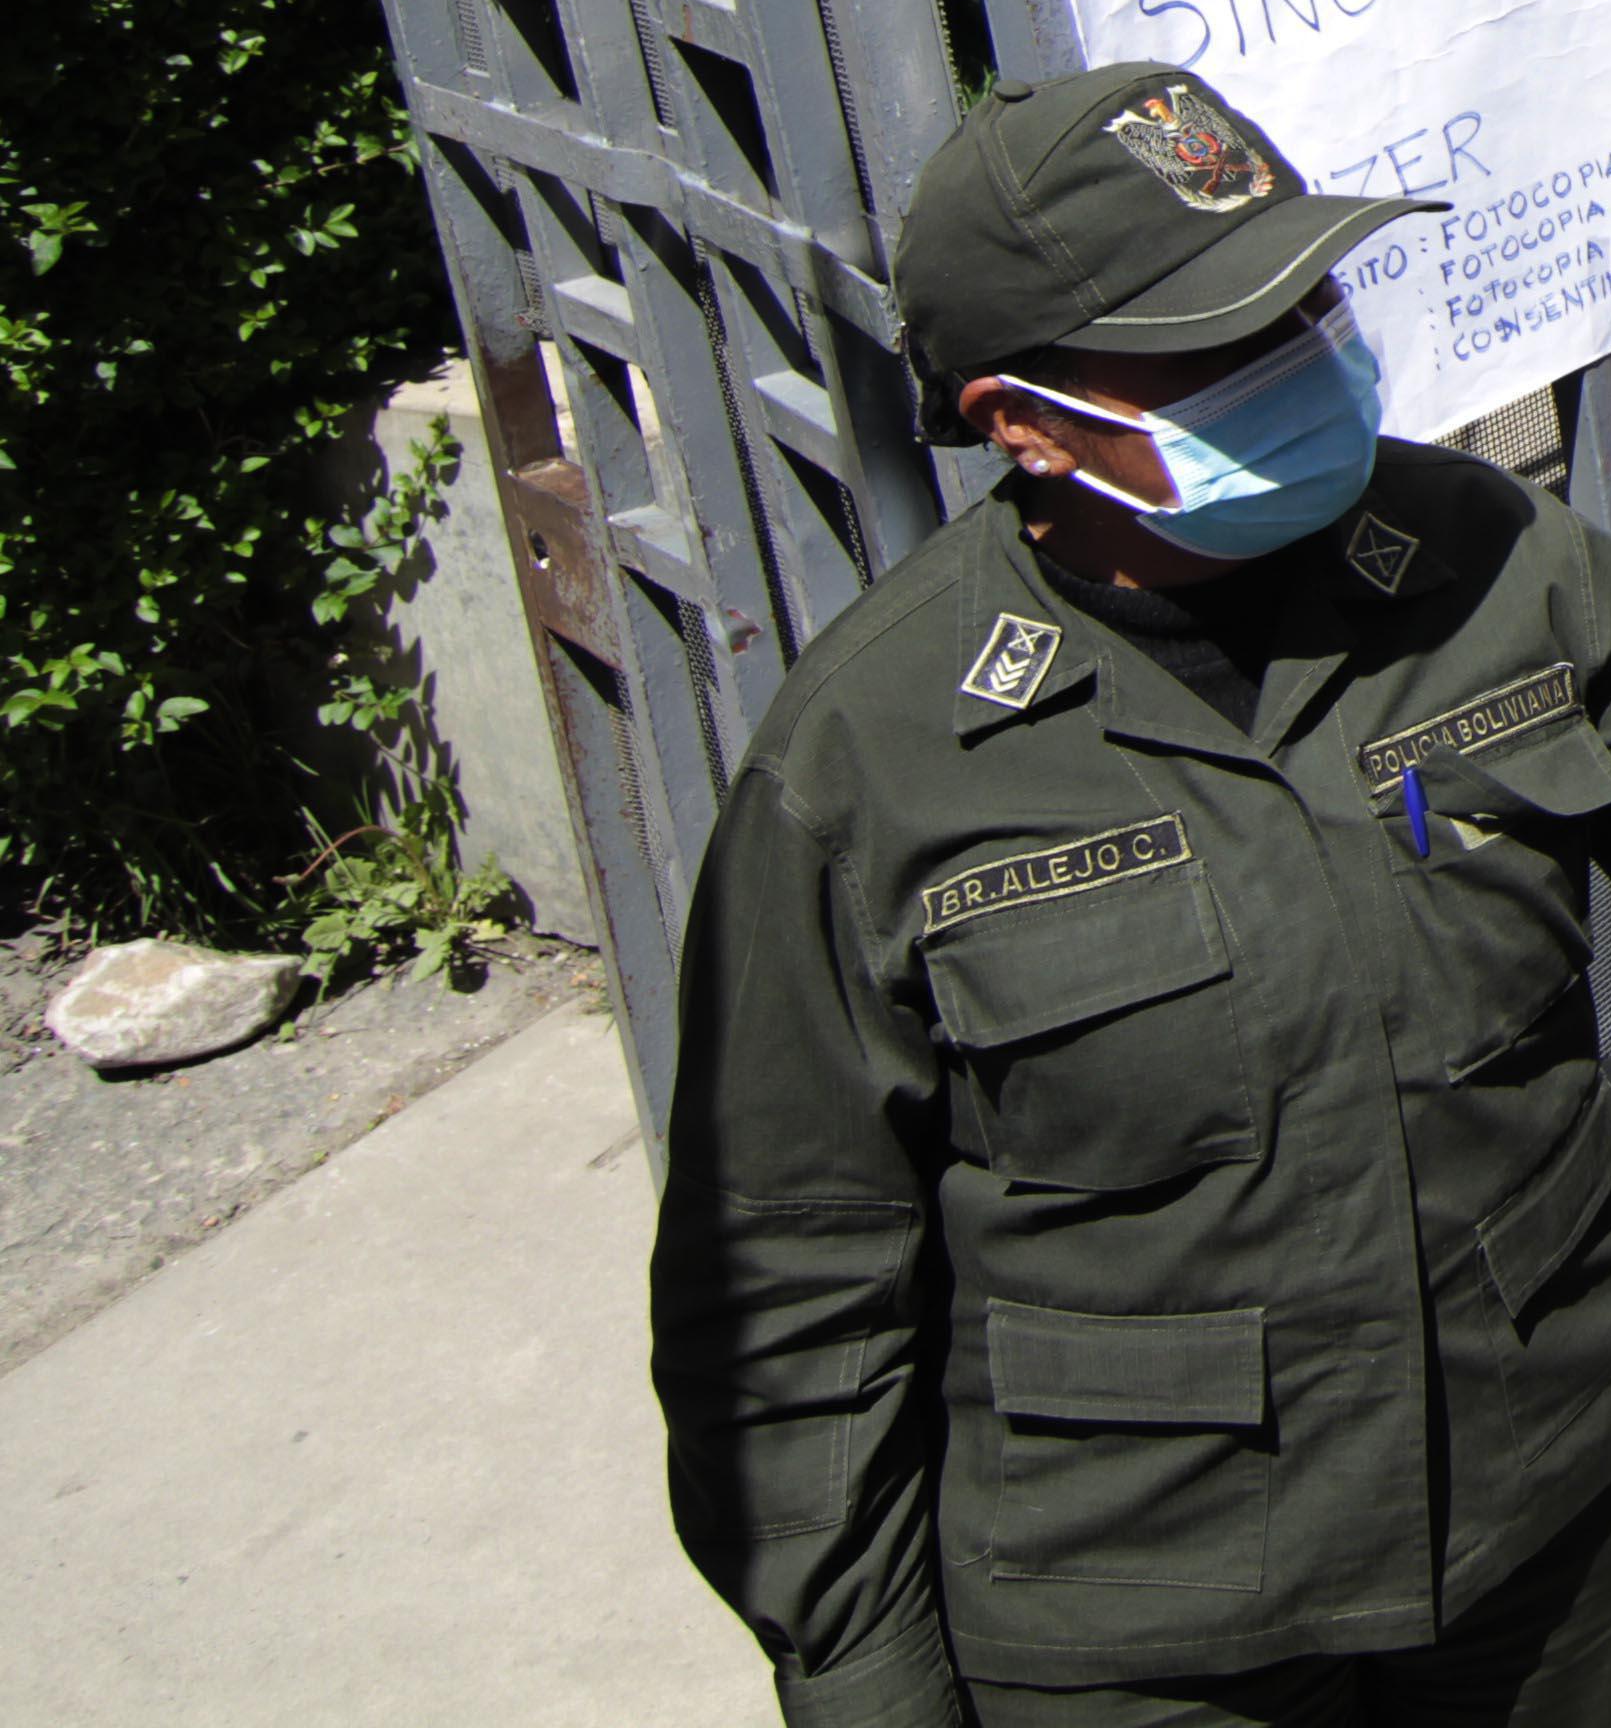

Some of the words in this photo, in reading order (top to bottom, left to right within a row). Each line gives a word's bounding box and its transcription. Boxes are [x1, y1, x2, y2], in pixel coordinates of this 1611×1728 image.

[1439, 200, 1606, 286] FOTOCOPIA
[1445, 239, 1605, 328] FOTOCOPIA
[1456, 678, 1567, 743] BOLIVIANA
